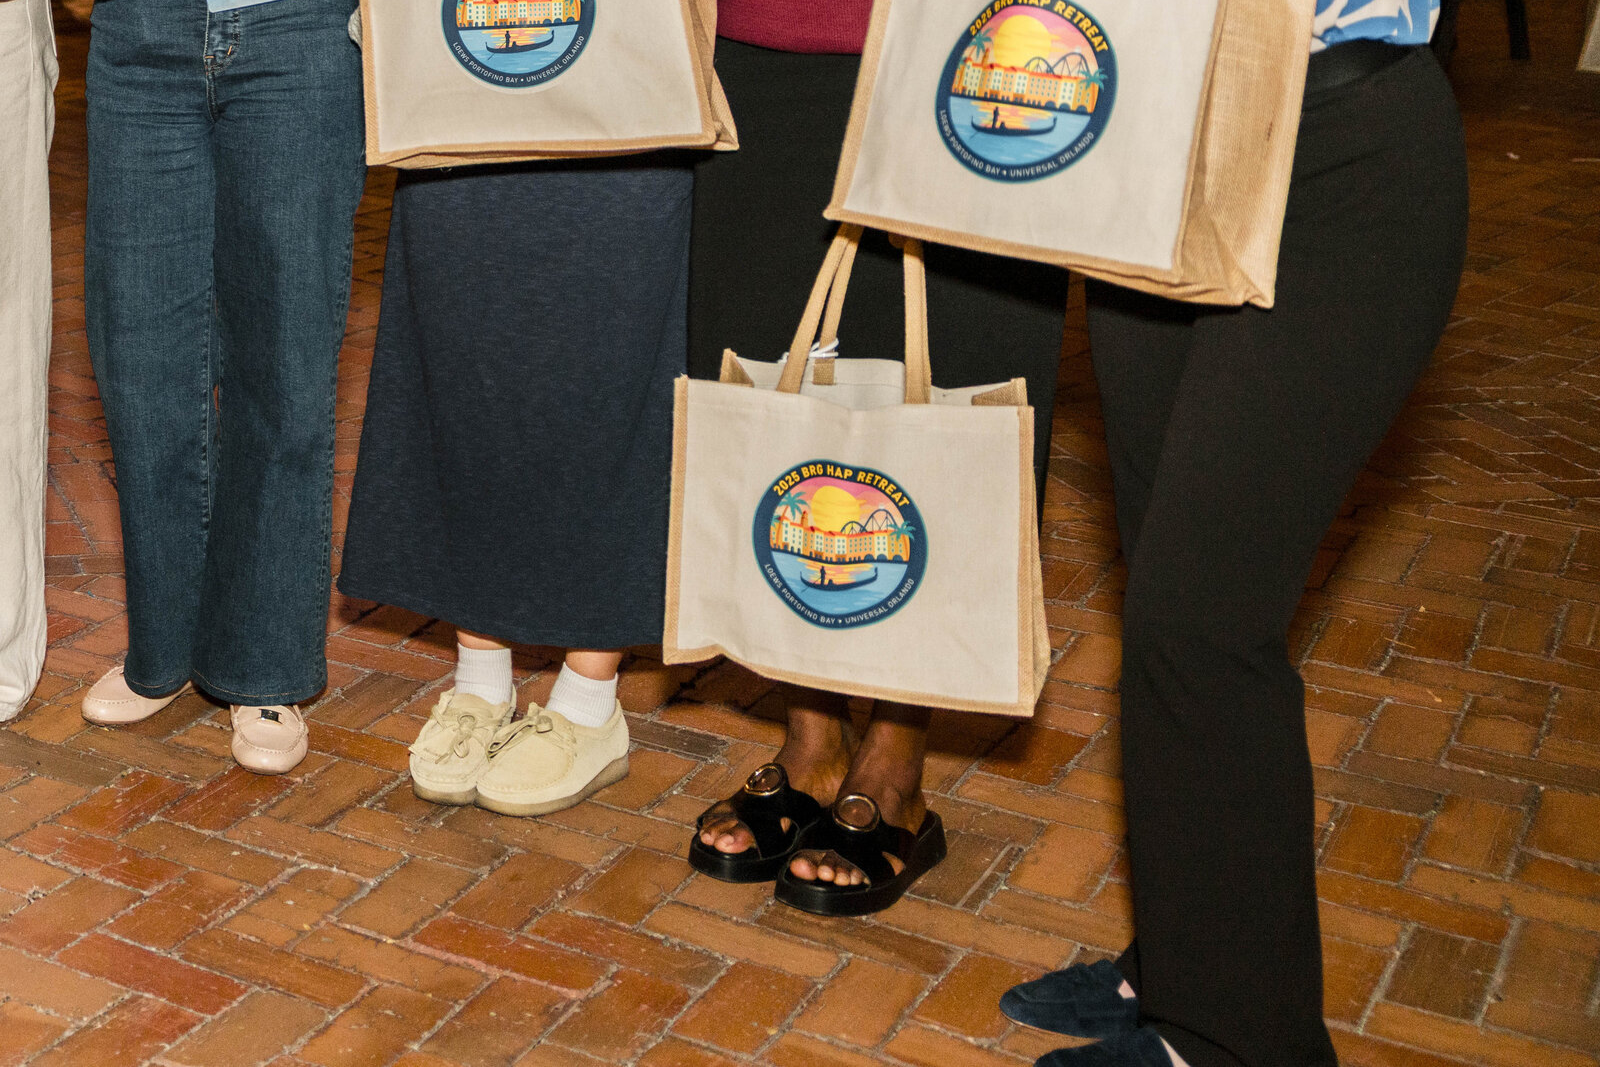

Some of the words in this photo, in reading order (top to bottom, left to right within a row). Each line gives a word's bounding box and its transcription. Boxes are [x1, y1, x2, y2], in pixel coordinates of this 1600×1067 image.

[969, 10, 993, 36] 2025
[1054, 0, 1108, 52] RETREAT
[453, 42, 469, 62] LOEWS
[469, 61, 504, 82] PORTOFINO
[527, 64, 563, 82] UNIVERSAL
[562, 36, 585, 64] ORLANDO
[773, 472, 800, 496] 2025
[801, 464, 824, 478] BRG
[827, 464, 853, 479] HAP
[856, 471, 910, 507] RETREAT
[764, 564, 782, 588] LOEWS
[782, 588, 818, 620] PORTOFINO
[820, 616, 836, 624] BAY
[845, 606, 888, 624] UNIVERSAL
[887, 578, 915, 608] ORLANDO
